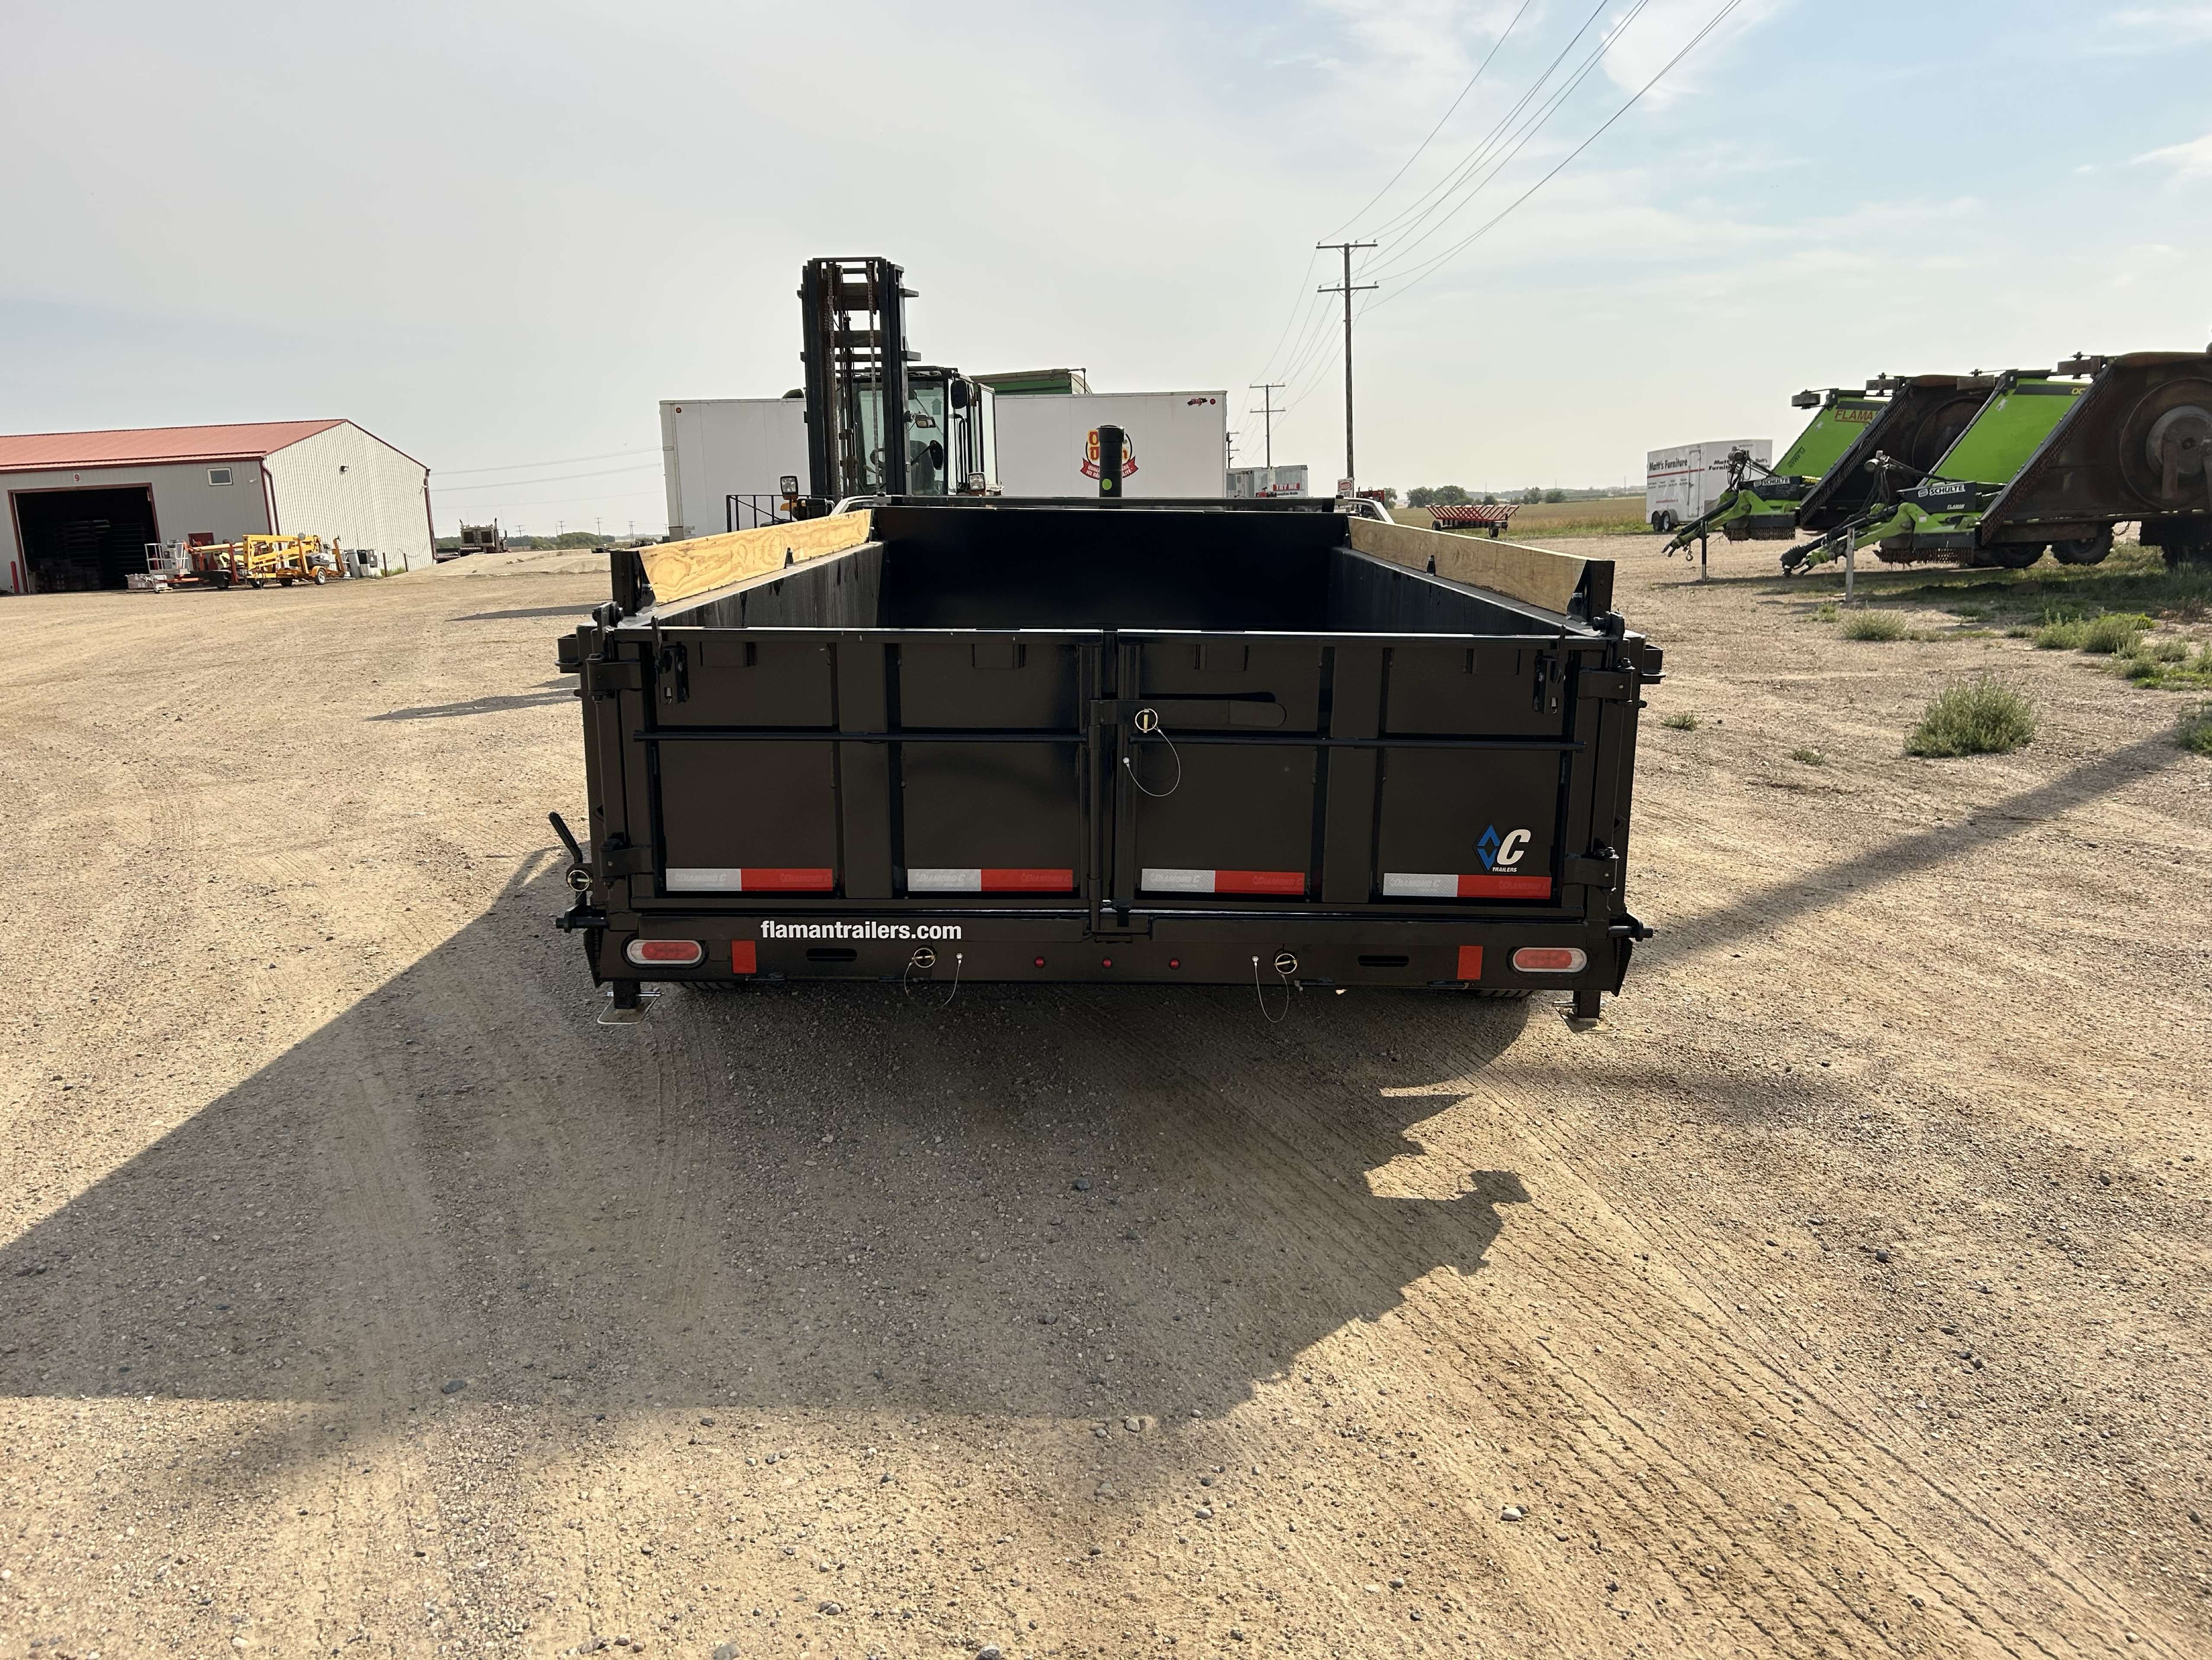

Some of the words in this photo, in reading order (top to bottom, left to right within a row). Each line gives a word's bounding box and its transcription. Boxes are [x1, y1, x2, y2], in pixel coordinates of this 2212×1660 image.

[1835, 409, 1878, 421] FLAMA
[1649, 460, 1664, 471] Matt's
[1665, 457, 1687, 469] Furniture
[75, 474, 80, 482] 9
[1763, 477, 1790, 486] SCHULTE
[1929, 485, 1965, 496] SCHULTE
[761, 920, 962, 939] flamantrailers.com
